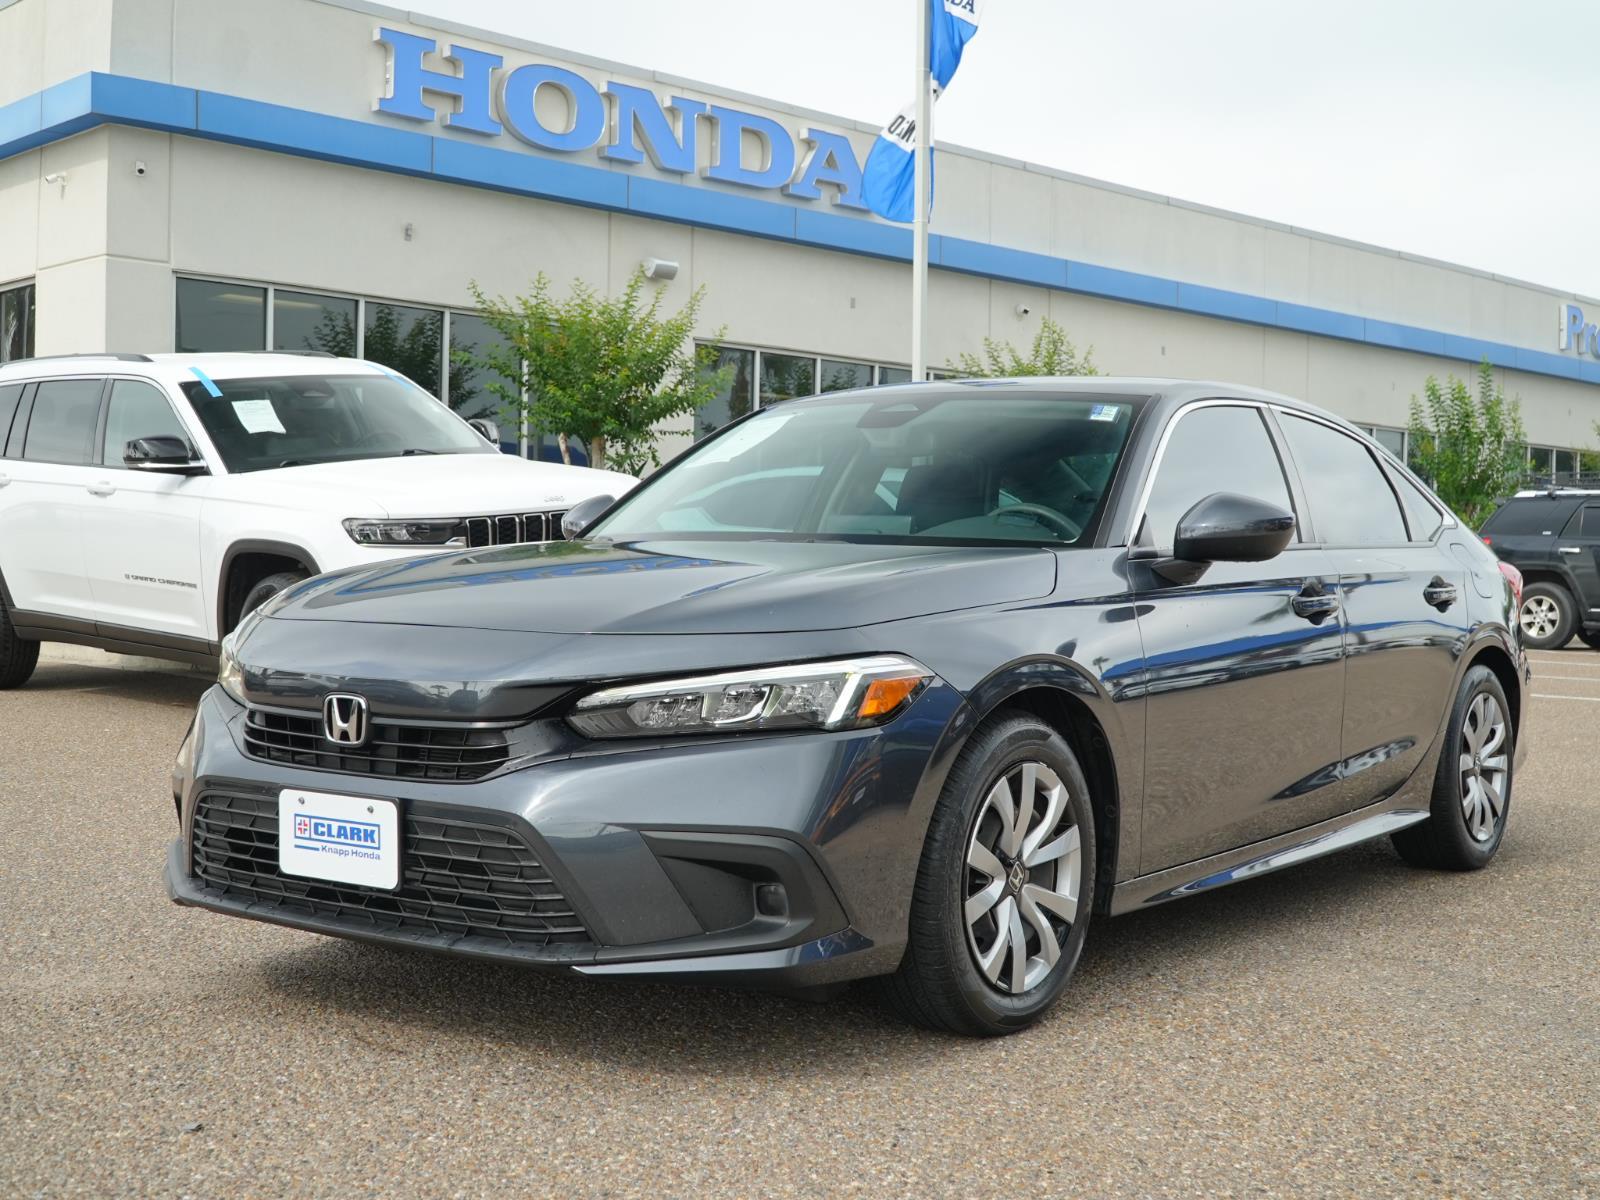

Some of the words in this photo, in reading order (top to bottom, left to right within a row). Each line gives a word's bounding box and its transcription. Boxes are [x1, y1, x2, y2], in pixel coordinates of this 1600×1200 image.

[374, 27, 868, 211] HONDA
[1560, 304, 1600, 359] Pr
[313, 822, 376, 844] CLARK
[321, 845, 350, 857] Knapp
[351, 849, 381, 860] Honda
